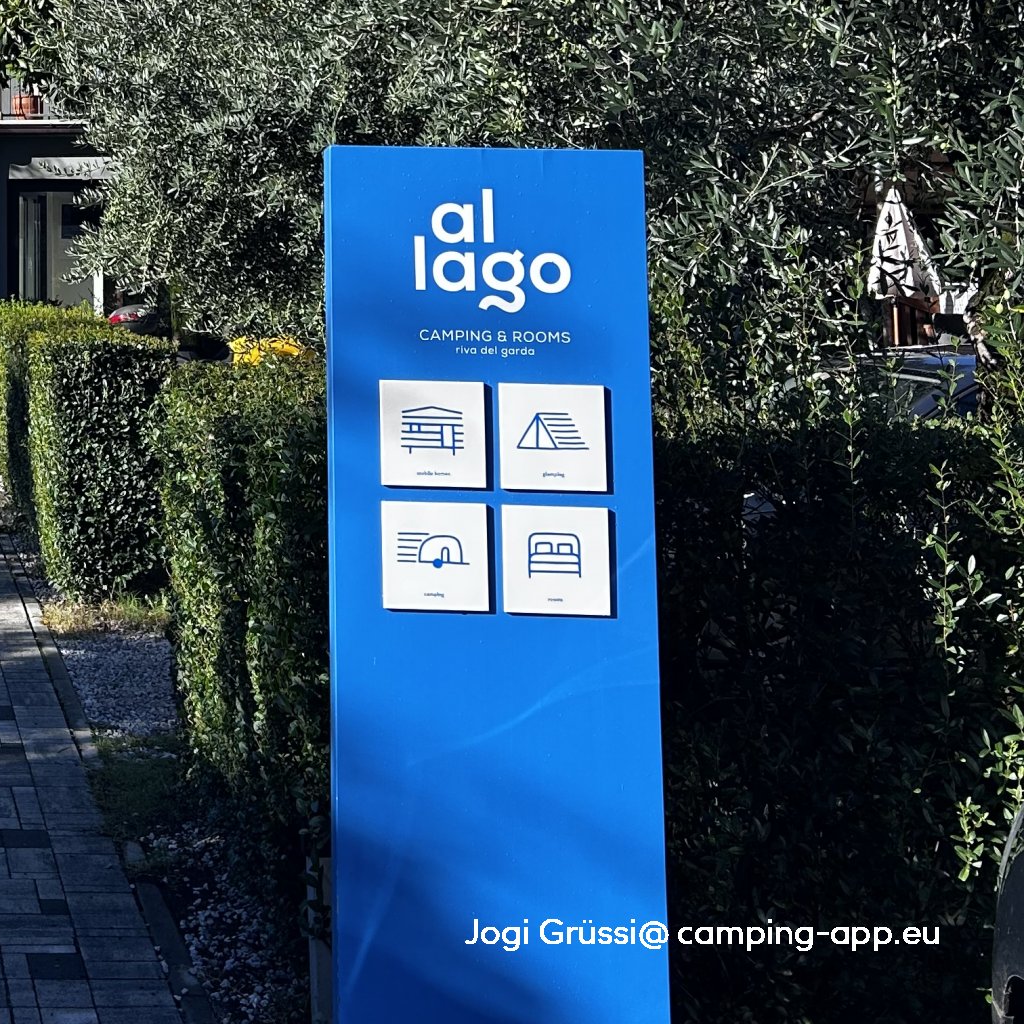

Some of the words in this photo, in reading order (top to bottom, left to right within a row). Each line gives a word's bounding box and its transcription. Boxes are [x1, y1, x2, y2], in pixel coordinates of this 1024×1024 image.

[431, 188, 495, 243] al
[413, 235, 572, 314] lago
[419, 329, 492, 342] CAMPING
[497, 330, 507, 342] &
[512, 331, 571, 344] ROOMS
[455, 345, 477, 355] riva
[480, 345, 498, 356] del
[501, 346, 535, 358] garda
